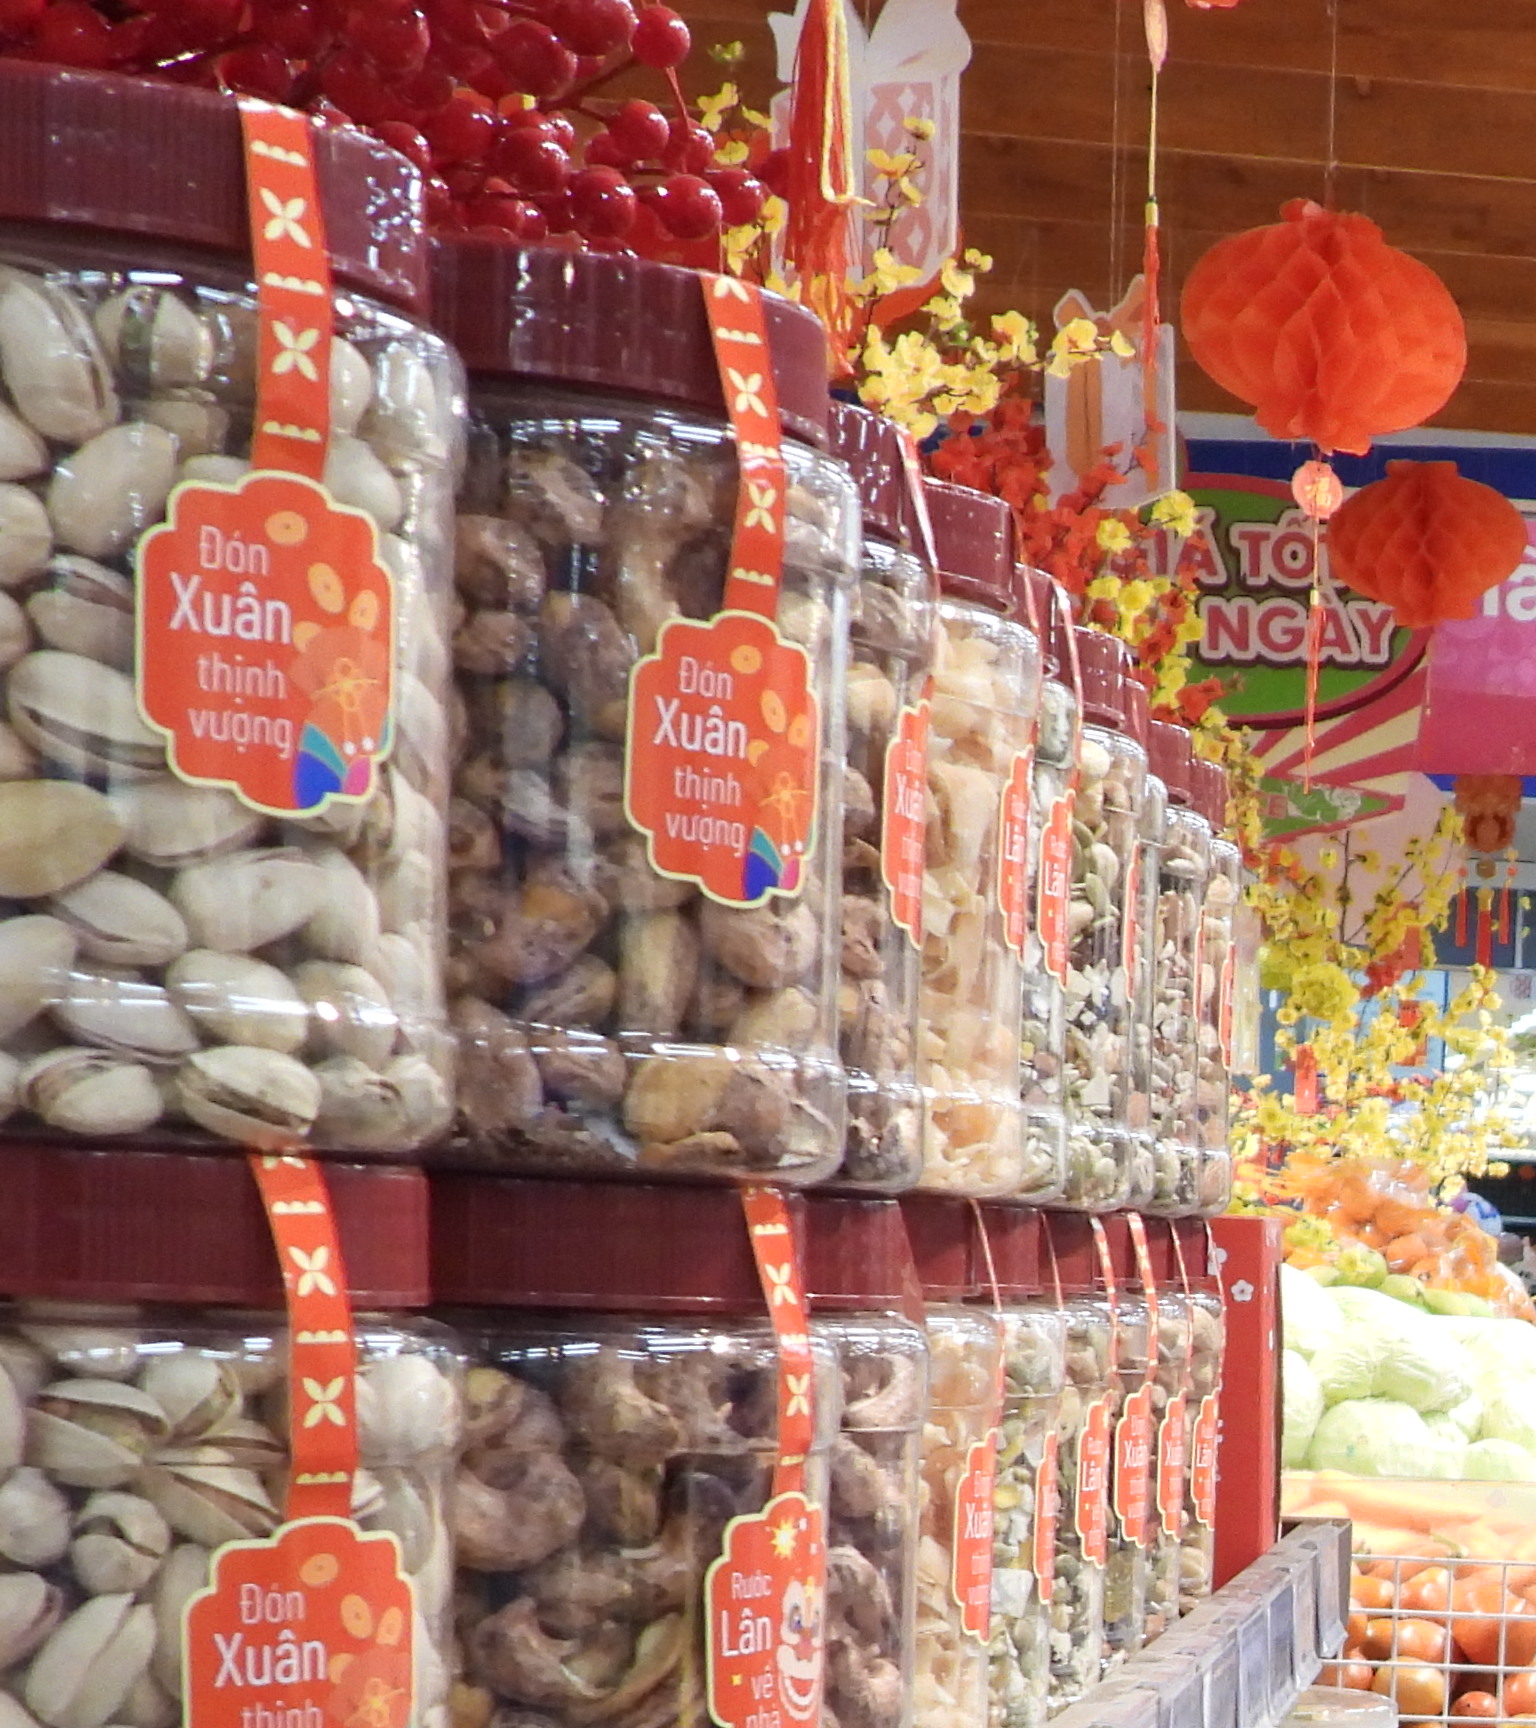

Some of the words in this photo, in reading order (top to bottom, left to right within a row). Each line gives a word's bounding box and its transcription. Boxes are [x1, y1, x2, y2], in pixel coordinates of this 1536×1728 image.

[199, 524, 271, 577] Đón
[167, 570, 293, 647] Xuân
[197, 652, 286, 709] thịnh
[679, 652, 734, 703] Đón
[186, 702, 295, 760] vượng
[651, 694, 748, 761] Xuân
[672, 762, 742, 816] thịnh
[663, 805, 747, 854] vượng
[239, 1580, 306, 1626] Đón
[212, 1626, 331, 1689] Xuân
[719, 1608, 773, 1659] Lân
